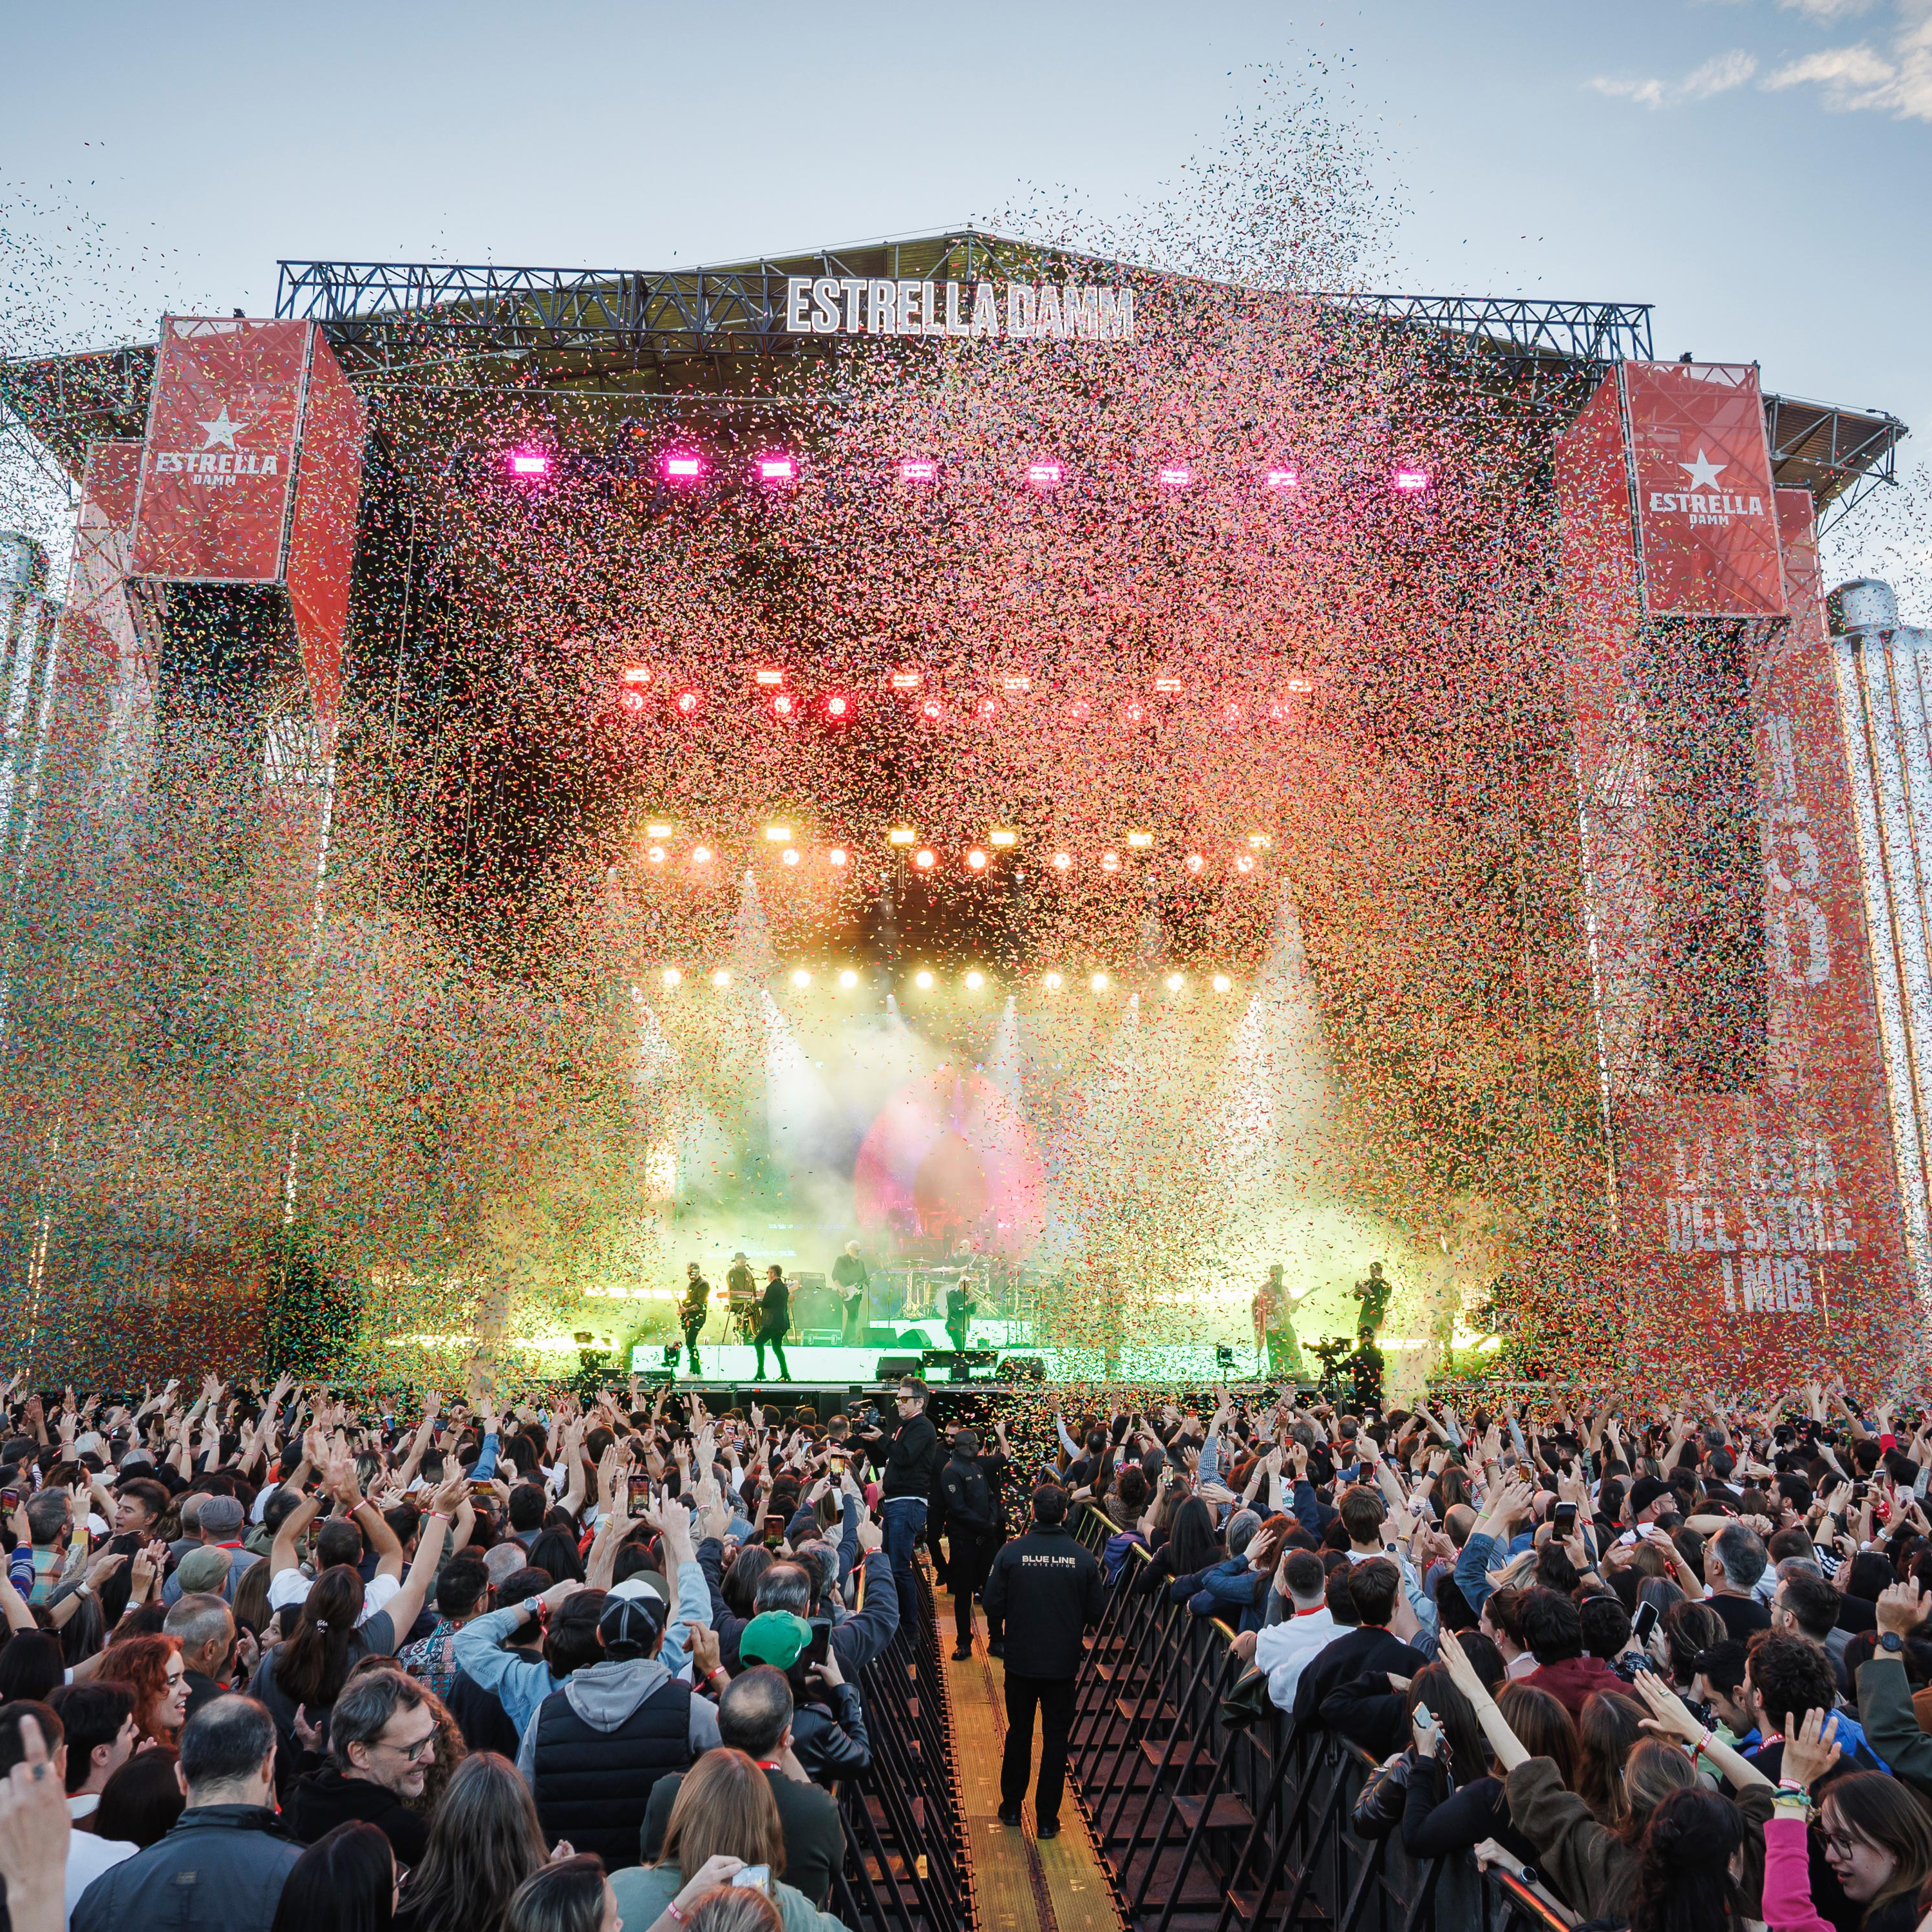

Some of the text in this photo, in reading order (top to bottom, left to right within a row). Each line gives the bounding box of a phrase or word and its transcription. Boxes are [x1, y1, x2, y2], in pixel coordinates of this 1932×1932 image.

[786, 278, 1134, 341] ESTRELLA DAMM
[156, 452, 278, 475] ESTRELLA
[193, 474, 236, 486] DAMM
[1651, 492, 1764, 516] ESTRELLA
[1689, 514, 1730, 526] DAMM
[1052, 1556, 1075, 1564] LINE
